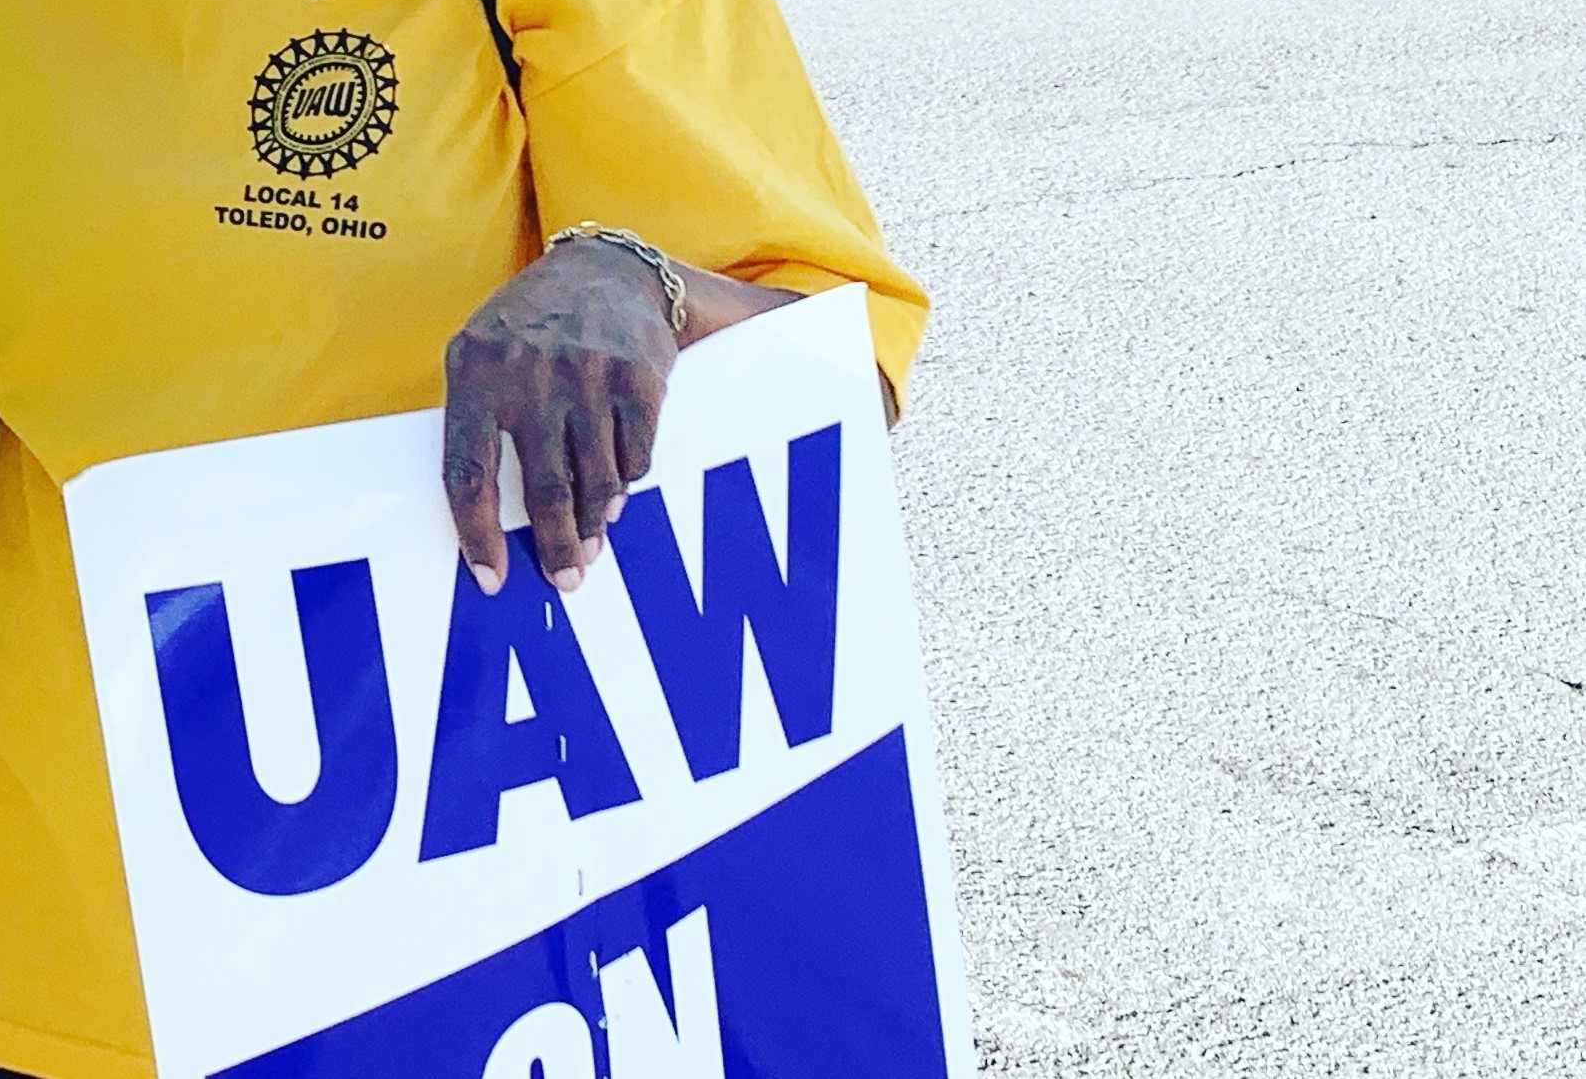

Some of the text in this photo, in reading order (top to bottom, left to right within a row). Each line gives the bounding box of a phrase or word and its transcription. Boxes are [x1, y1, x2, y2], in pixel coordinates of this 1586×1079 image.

[291, 81, 356, 120] UAW
[243, 184, 359, 212] LOCAL 14
[214, 205, 387, 240] TOLEDO, OHIO
[144, 421, 843, 897] UAW
